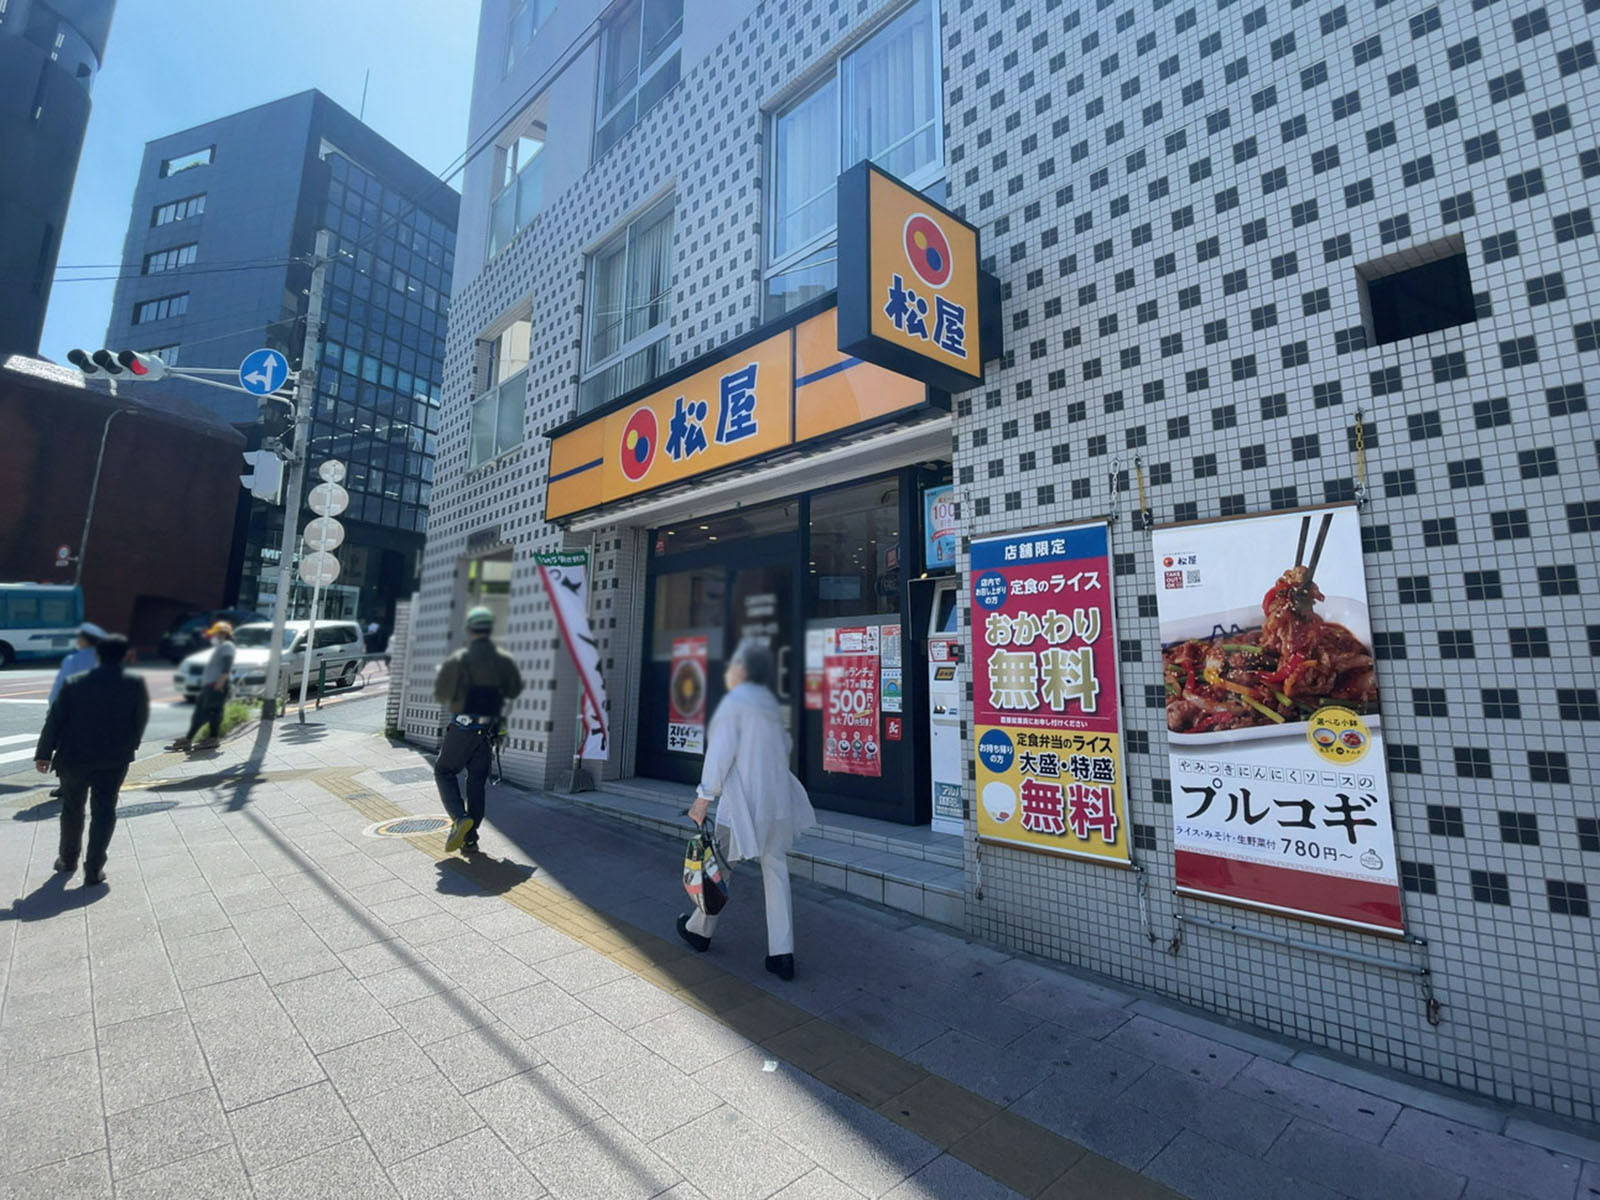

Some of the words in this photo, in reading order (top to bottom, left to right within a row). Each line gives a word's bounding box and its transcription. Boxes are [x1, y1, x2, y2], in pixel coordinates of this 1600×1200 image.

[884, 273, 968, 358] 松屋
[665, 362, 758, 462] 松屋
[1004, 538, 1066, 560] 店舗限定
[1010, 571, 1101, 595] 定食のライス
[985, 607, 1102, 645] おかわり
[988, 646, 1099, 712] 無料
[979, 743, 1013, 754] お持ち帰り
[1017, 732, 1113, 754] 定食弁当のライス
[990, 755, 1004, 764] の方
[1019, 751, 1115, 783] 大盛・特盛
[1179, 760, 1375, 789] やみつきにんにくソースの
[1020, 778, 1117, 842] 無料
[1180, 777, 1378, 845] プルコギ
[1175, 825, 1276, 850] ライス・みそ汁・生野菜付
